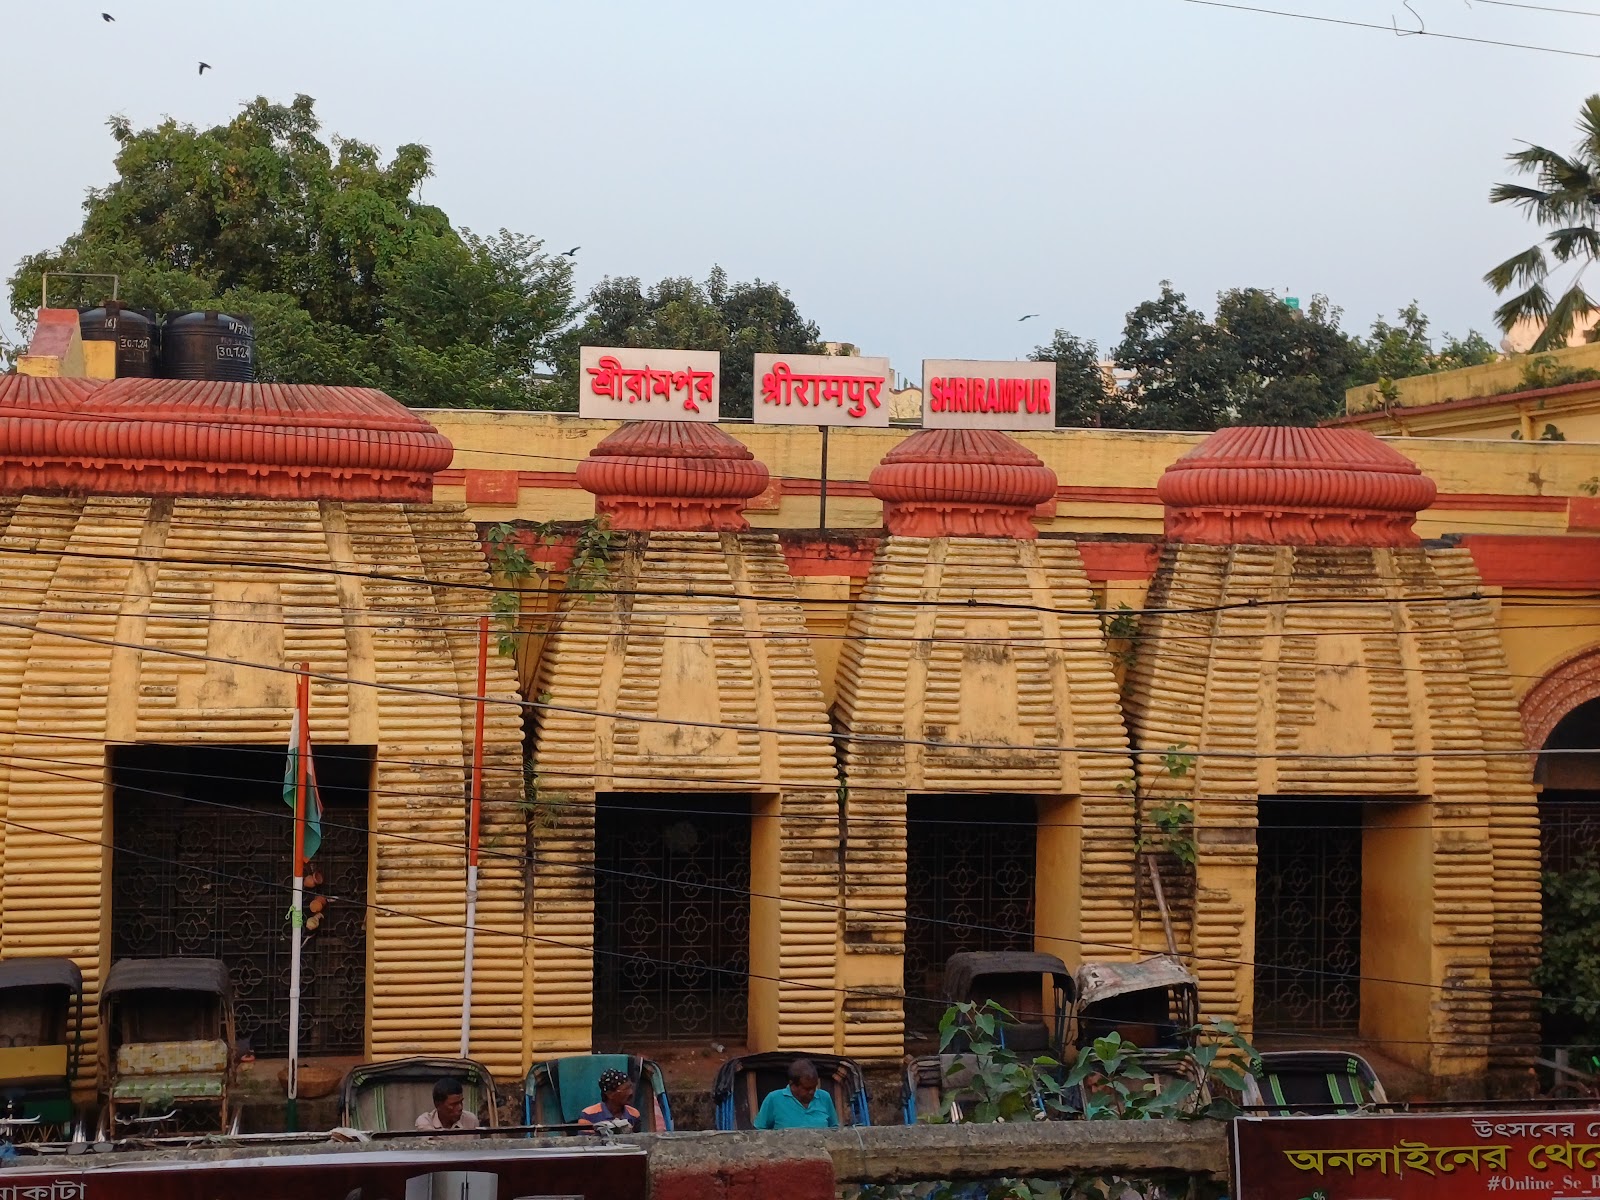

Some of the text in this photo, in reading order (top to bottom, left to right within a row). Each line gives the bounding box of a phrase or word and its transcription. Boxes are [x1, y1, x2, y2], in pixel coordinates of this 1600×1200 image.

[585, 355, 715, 414] শ্রীরামপুর
[761, 361, 886, 418] श्रीरामपुर
[929, 376, 1052, 415] SHRIRAMPUR
[1470, 1118, 1576, 1138] উৎসবের
[1282, 1138, 1513, 1176] অনলাইনের
